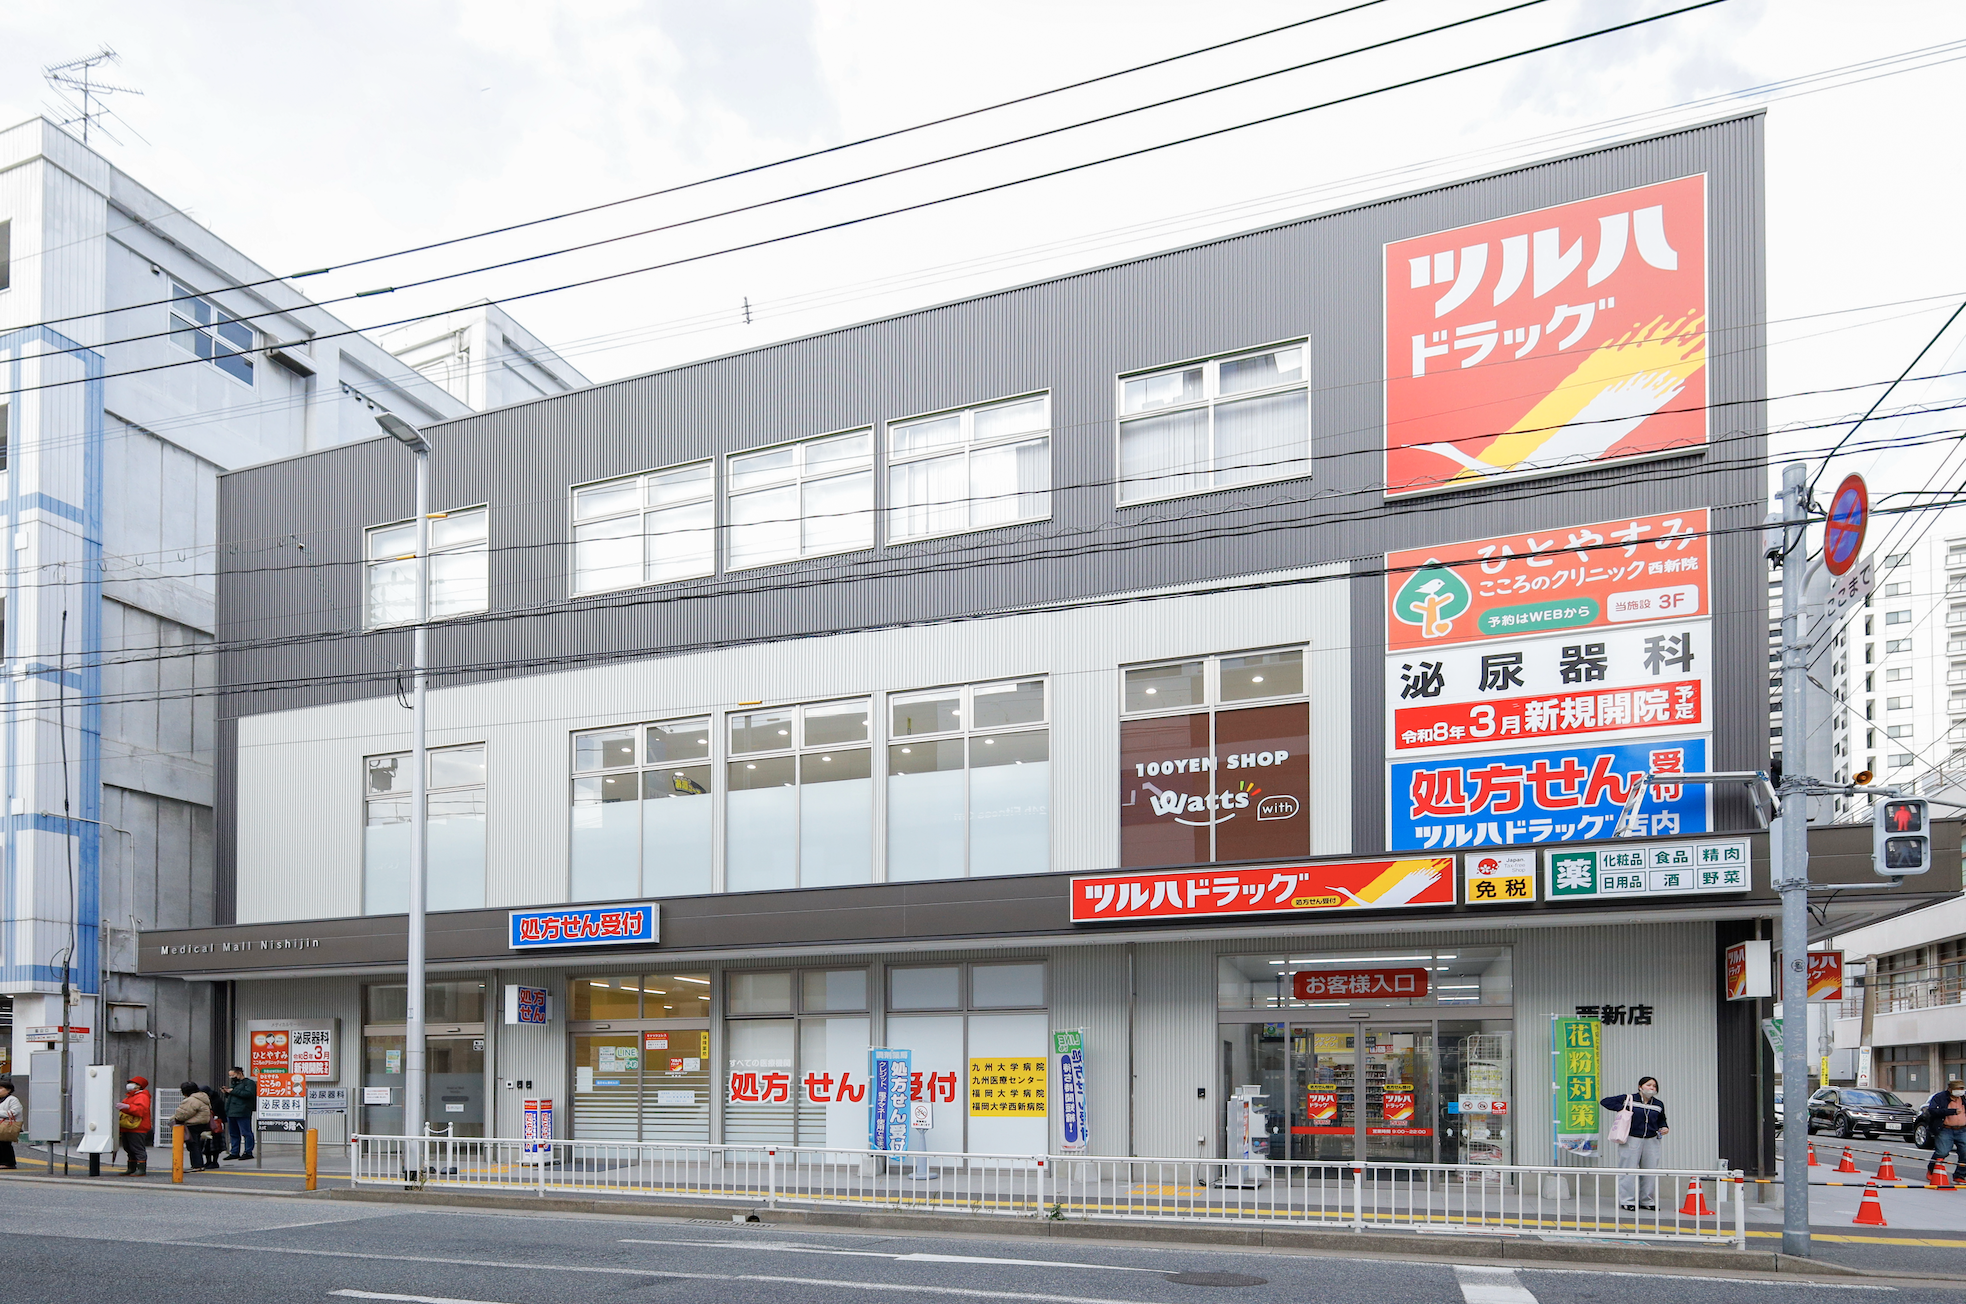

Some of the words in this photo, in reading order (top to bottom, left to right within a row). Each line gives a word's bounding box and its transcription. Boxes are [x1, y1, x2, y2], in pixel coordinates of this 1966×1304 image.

[1408, 204, 1678, 319] ツルハ
[1411, 296, 1615, 378] ドラッグ
[1477, 517, 1698, 574] ひとやすみ
[1827, 564, 1871, 617] ここまで
[1615, 599, 1651, 612] 当施設
[1658, 592, 1685, 610] 3F
[1488, 605, 1591, 628] 予約はWEBから
[1400, 631, 1695, 700] 泌尿器科
[1135, 756, 1218, 778] 100YEN
[1226, 750, 1289, 770] SHOP
[1262, 801, 1293, 814] with
[1603, 852, 1643, 867] 化粧品
[1655, 849, 1689, 865] 食品
[1702, 846, 1741, 862] 精肉
[1556, 858, 1593, 889] 薬
[1603, 873, 1643, 890] 日用品
[1663, 873, 1680, 887] 酒
[1702, 868, 1741, 885] 野菜
[1085, 872, 1310, 914] ツルハドラッグ
[1475, 878, 1526, 899] 免税
[520, 911, 644, 941] 処方せん受付
[161, 943, 214, 955] Medical
[222, 941, 251, 952] Mall
[260, 938, 319, 950] Nishijin
[1305, 974, 1415, 994] お客様入口
[293, 1031, 330, 1045] 泌尿器科
[252, 1050, 288, 1060] ひとやすみ
[617, 1048, 636, 1057] LINE
[729, 1058, 791, 1068] すべての医療機関
[972, 1063, 1045, 1072] 九州大学病院
[972, 1075, 1044, 1085] 九州医療センター
[1567, 1023, 1595, 1128] 花粉対策
[260, 1088, 286, 1096] クリニック
[309, 1090, 345, 1099] 泌尿器科
[972, 1089, 1045, 1098] 福岡大学病院
[1385, 1095, 1412, 1103] ツルハ
[261, 1099, 301, 1110] 泌尿器科
[888, 1061, 908, 1151] 処方せん受付
[972, 1102, 1045, 1111] 福岡大学西新病院
[283, 1121, 304, 1131] 3階へ
